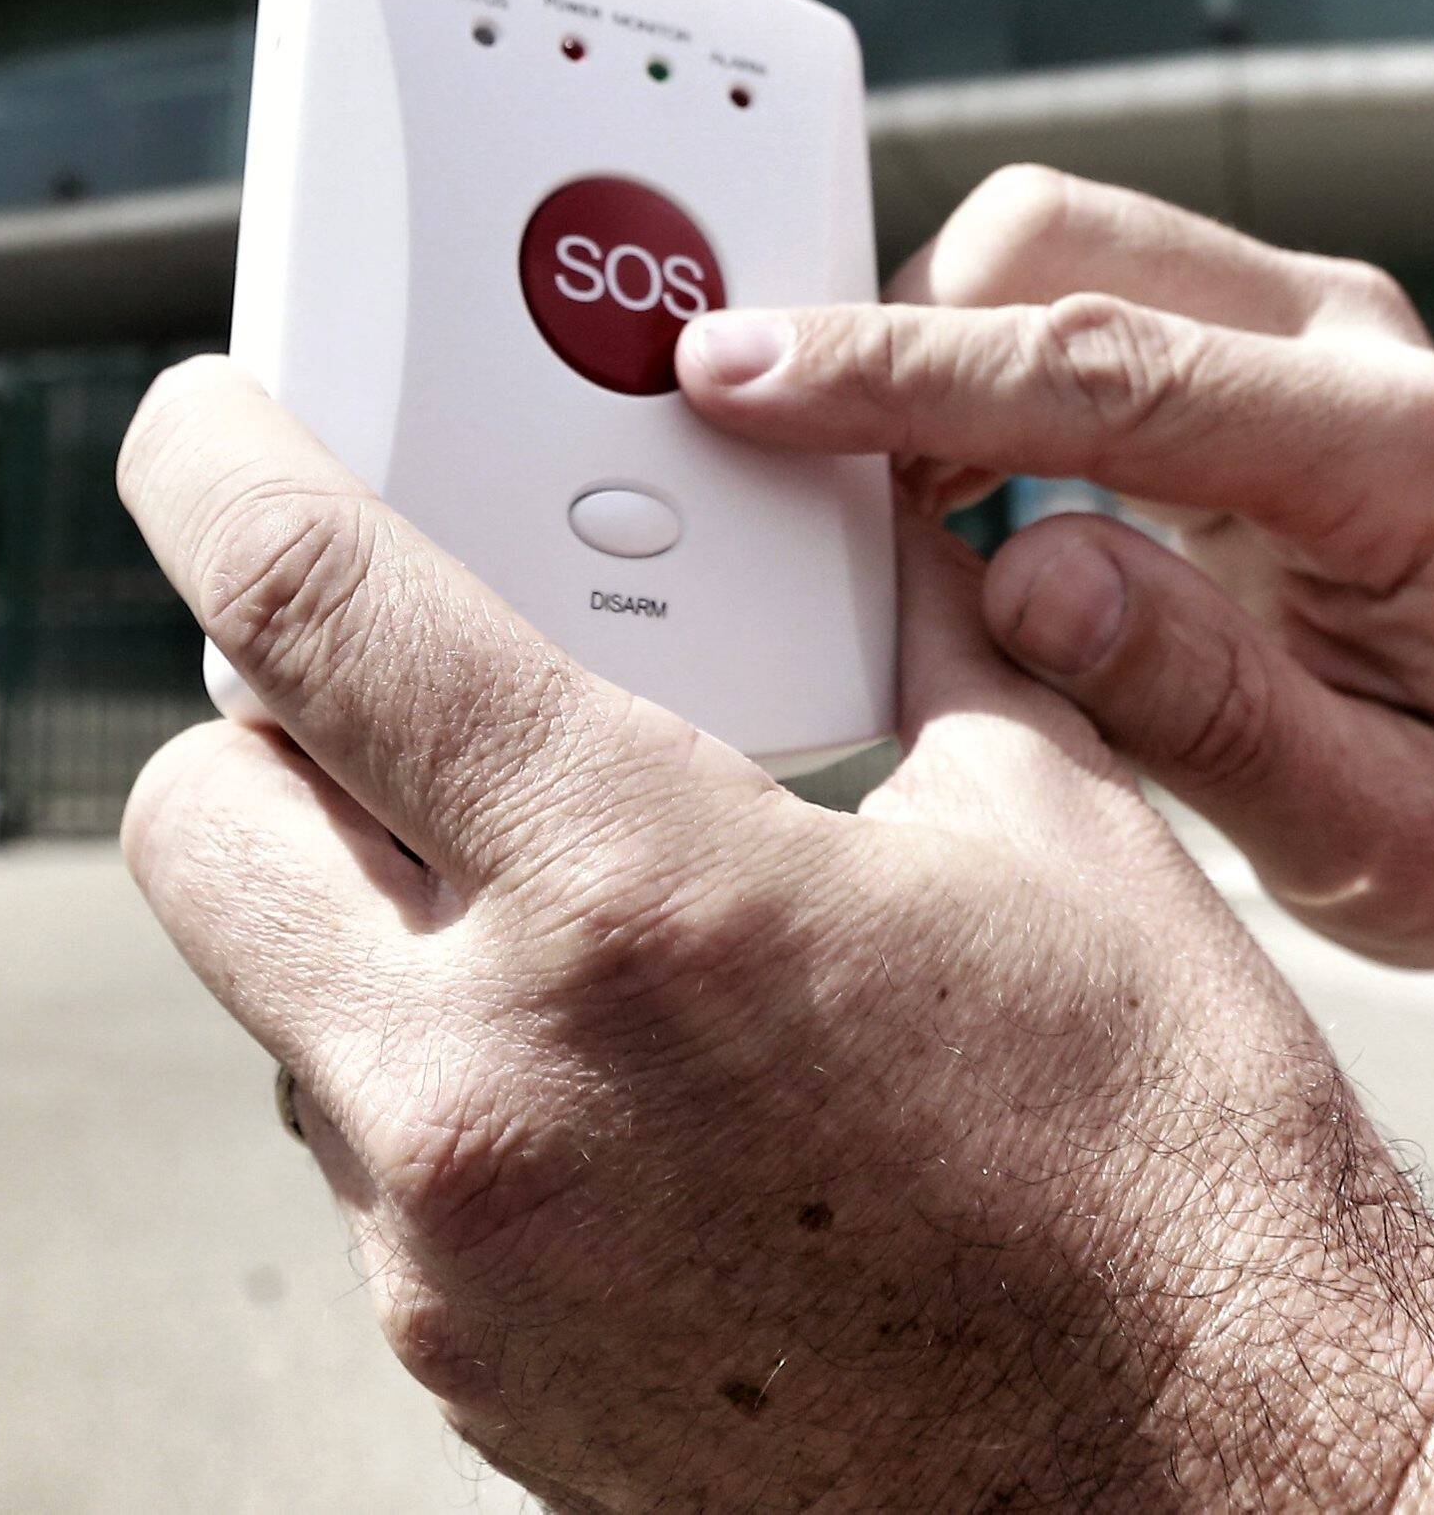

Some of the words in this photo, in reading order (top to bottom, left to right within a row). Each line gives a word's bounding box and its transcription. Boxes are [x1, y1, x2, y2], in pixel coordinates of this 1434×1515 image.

[612, 12, 692, 43] MONITOR
[709, 50, 767, 76] ALARM
[554, 234, 709, 321] SOS
[590, 590, 668, 620] DISARM
